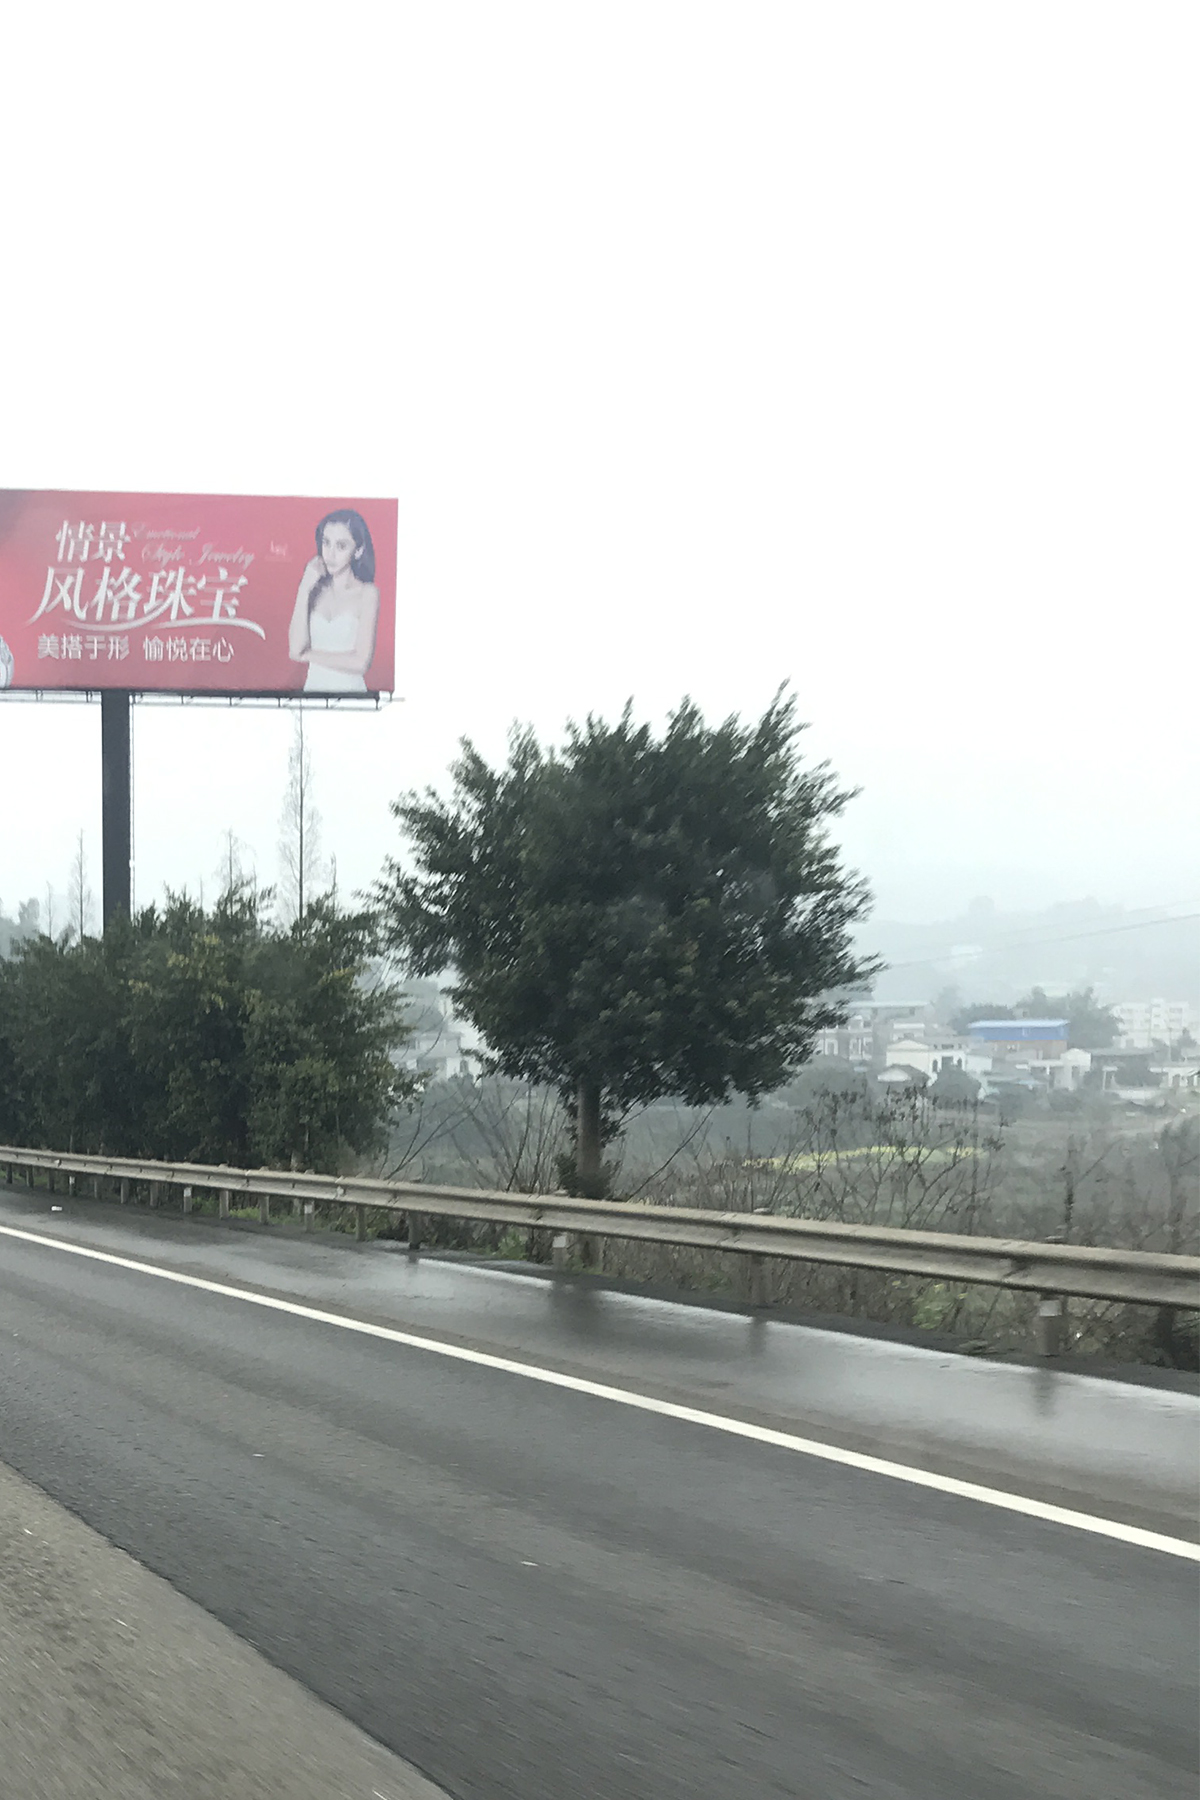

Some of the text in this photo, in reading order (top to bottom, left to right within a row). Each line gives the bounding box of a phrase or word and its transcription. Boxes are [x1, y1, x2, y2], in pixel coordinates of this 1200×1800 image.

[55, 520, 131, 562] 情景
[22, 566, 250, 626] 风格珠宝
[37, 633, 235, 662] 美搭于形 愉悦在心
